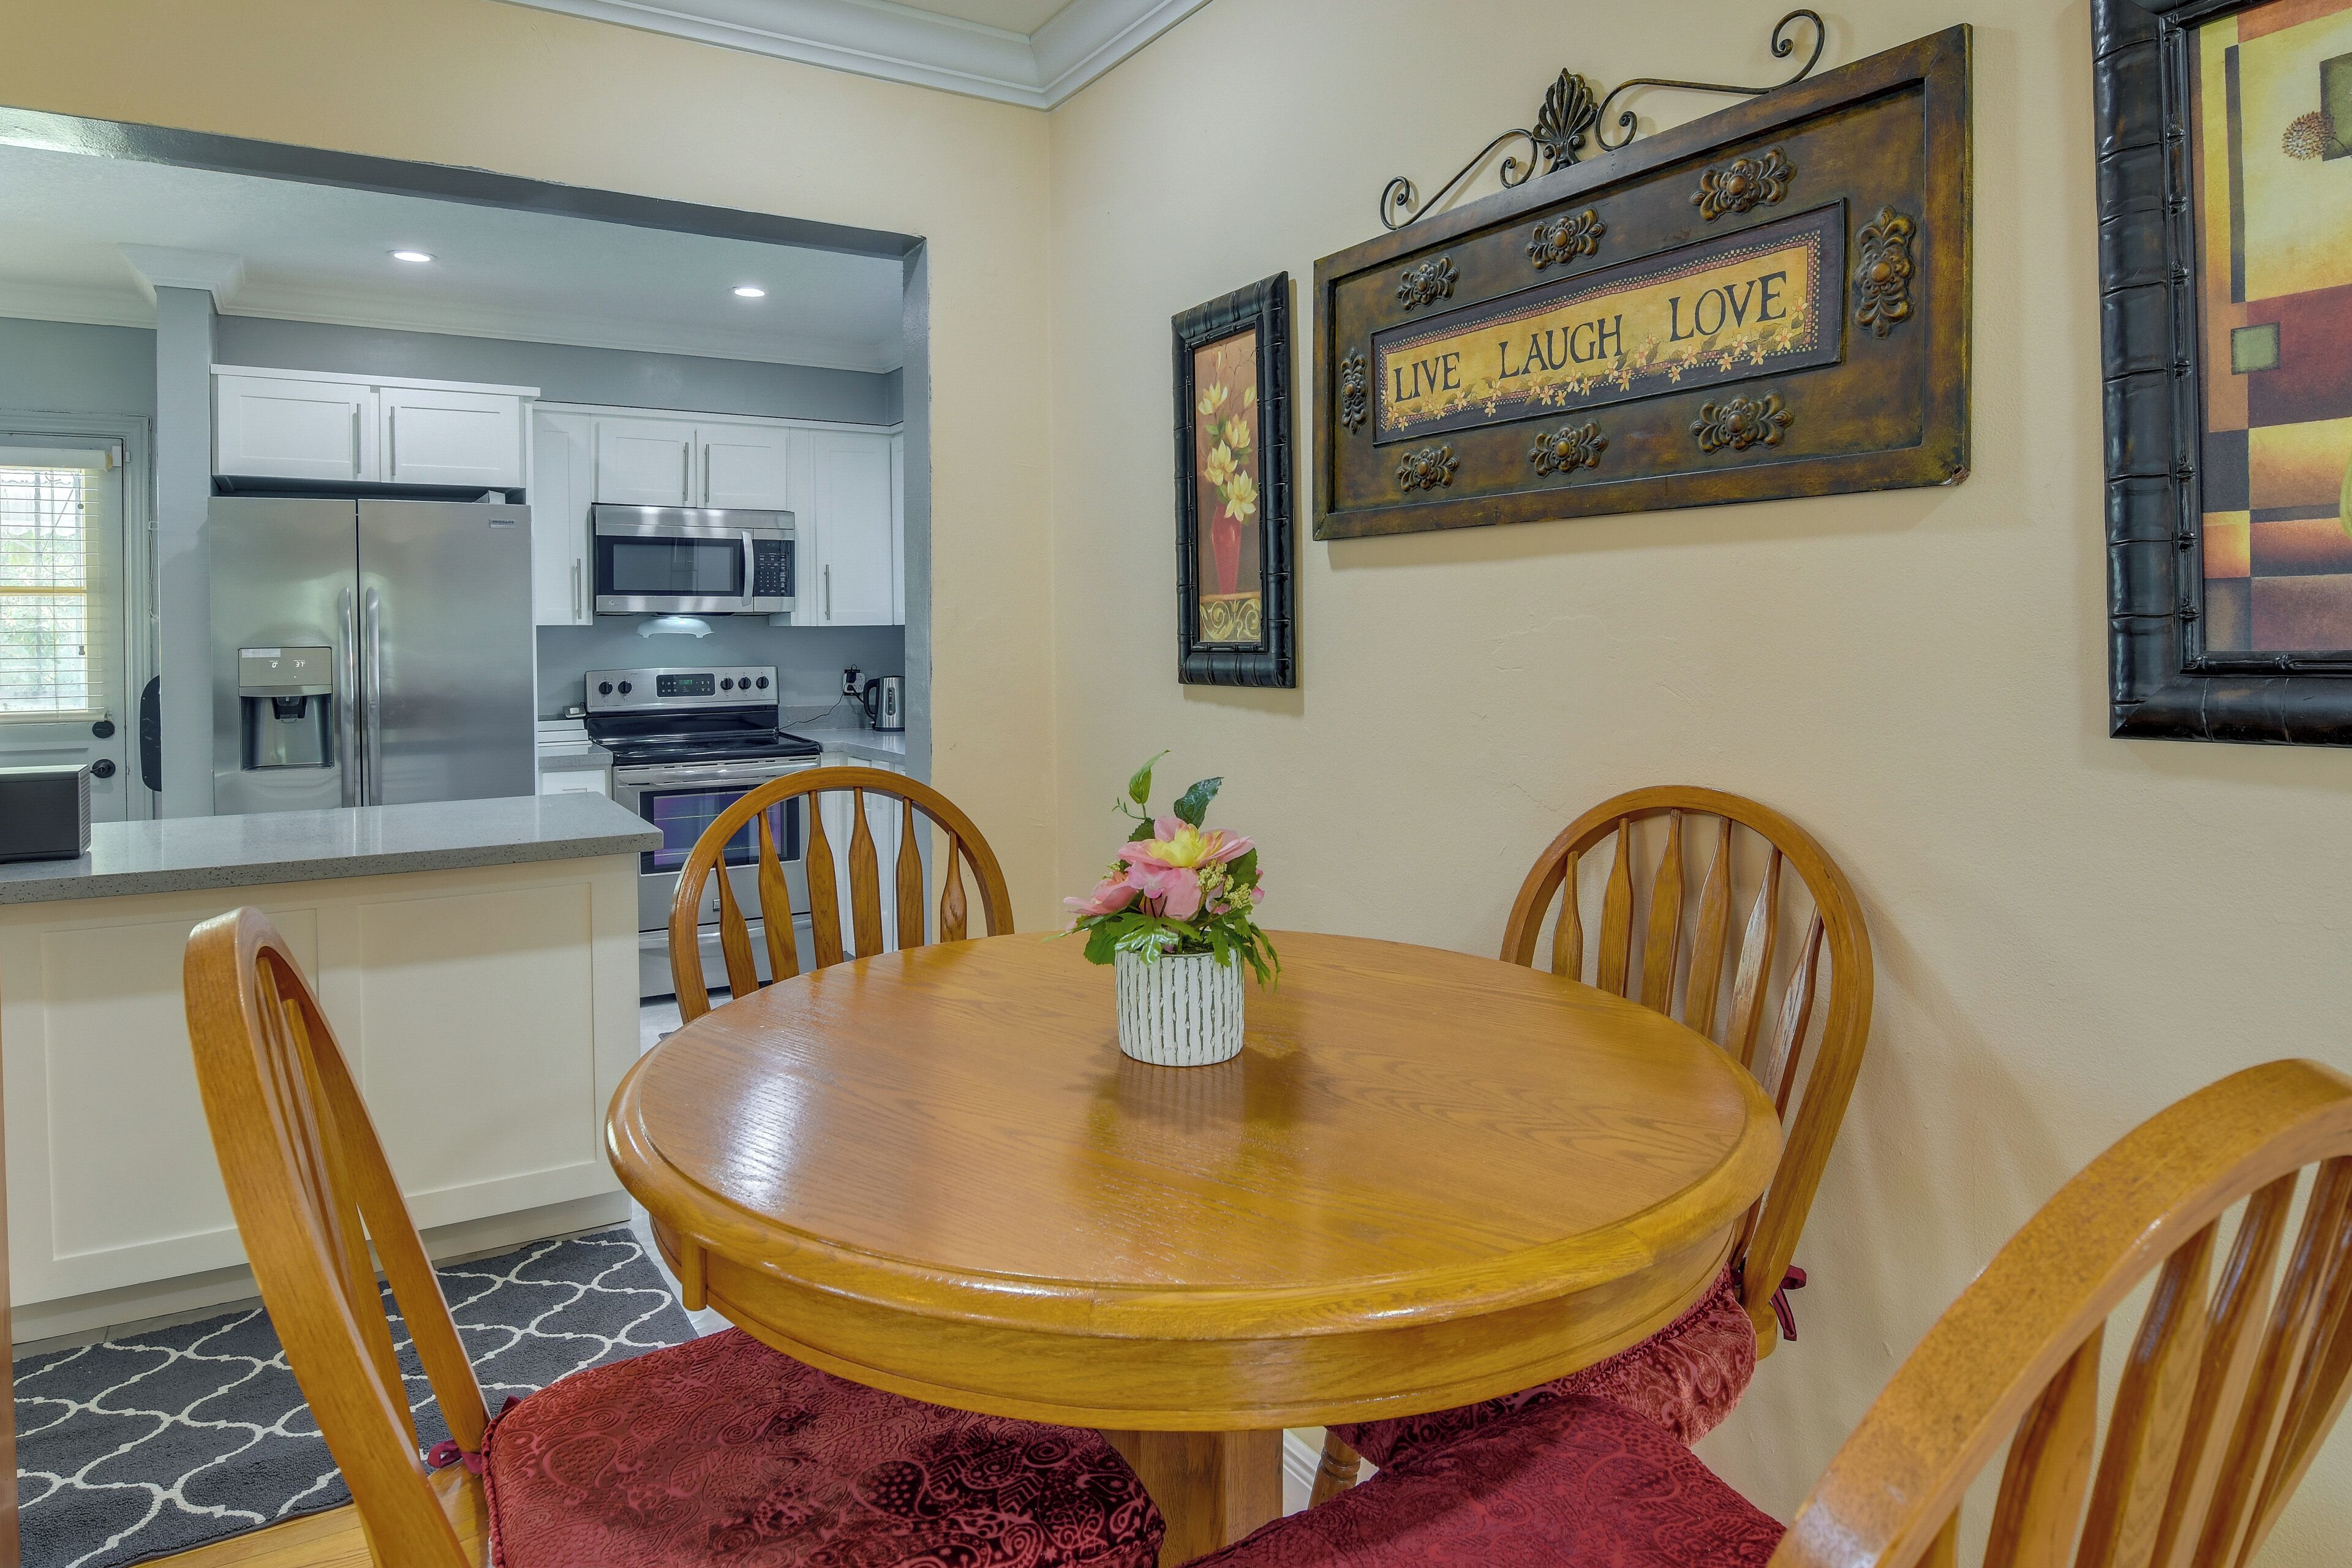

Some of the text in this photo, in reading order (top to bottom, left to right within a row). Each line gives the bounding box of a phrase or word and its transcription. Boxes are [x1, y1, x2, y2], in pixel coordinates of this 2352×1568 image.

[1393, 271, 1787, 403] LIVE LAUGH LOVE
